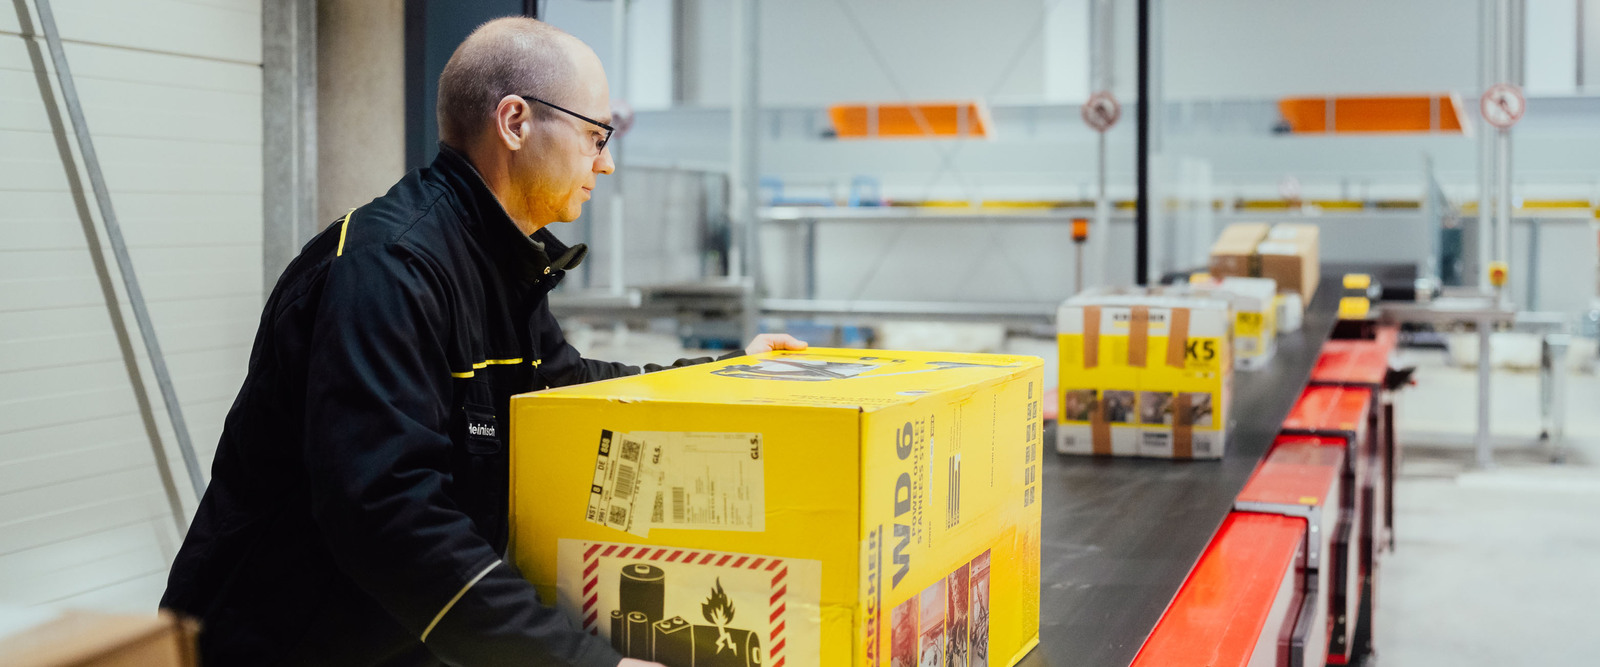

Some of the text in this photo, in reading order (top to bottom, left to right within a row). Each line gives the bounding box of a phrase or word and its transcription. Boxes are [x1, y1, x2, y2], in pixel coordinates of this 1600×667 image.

[1184, 340, 1215, 361] K 5
[588, 505, 597, 520] NST
[598, 461, 606, 471] DE
[892, 421, 914, 591] WD 6
[866, 529, 876, 667] ÄRCHER
